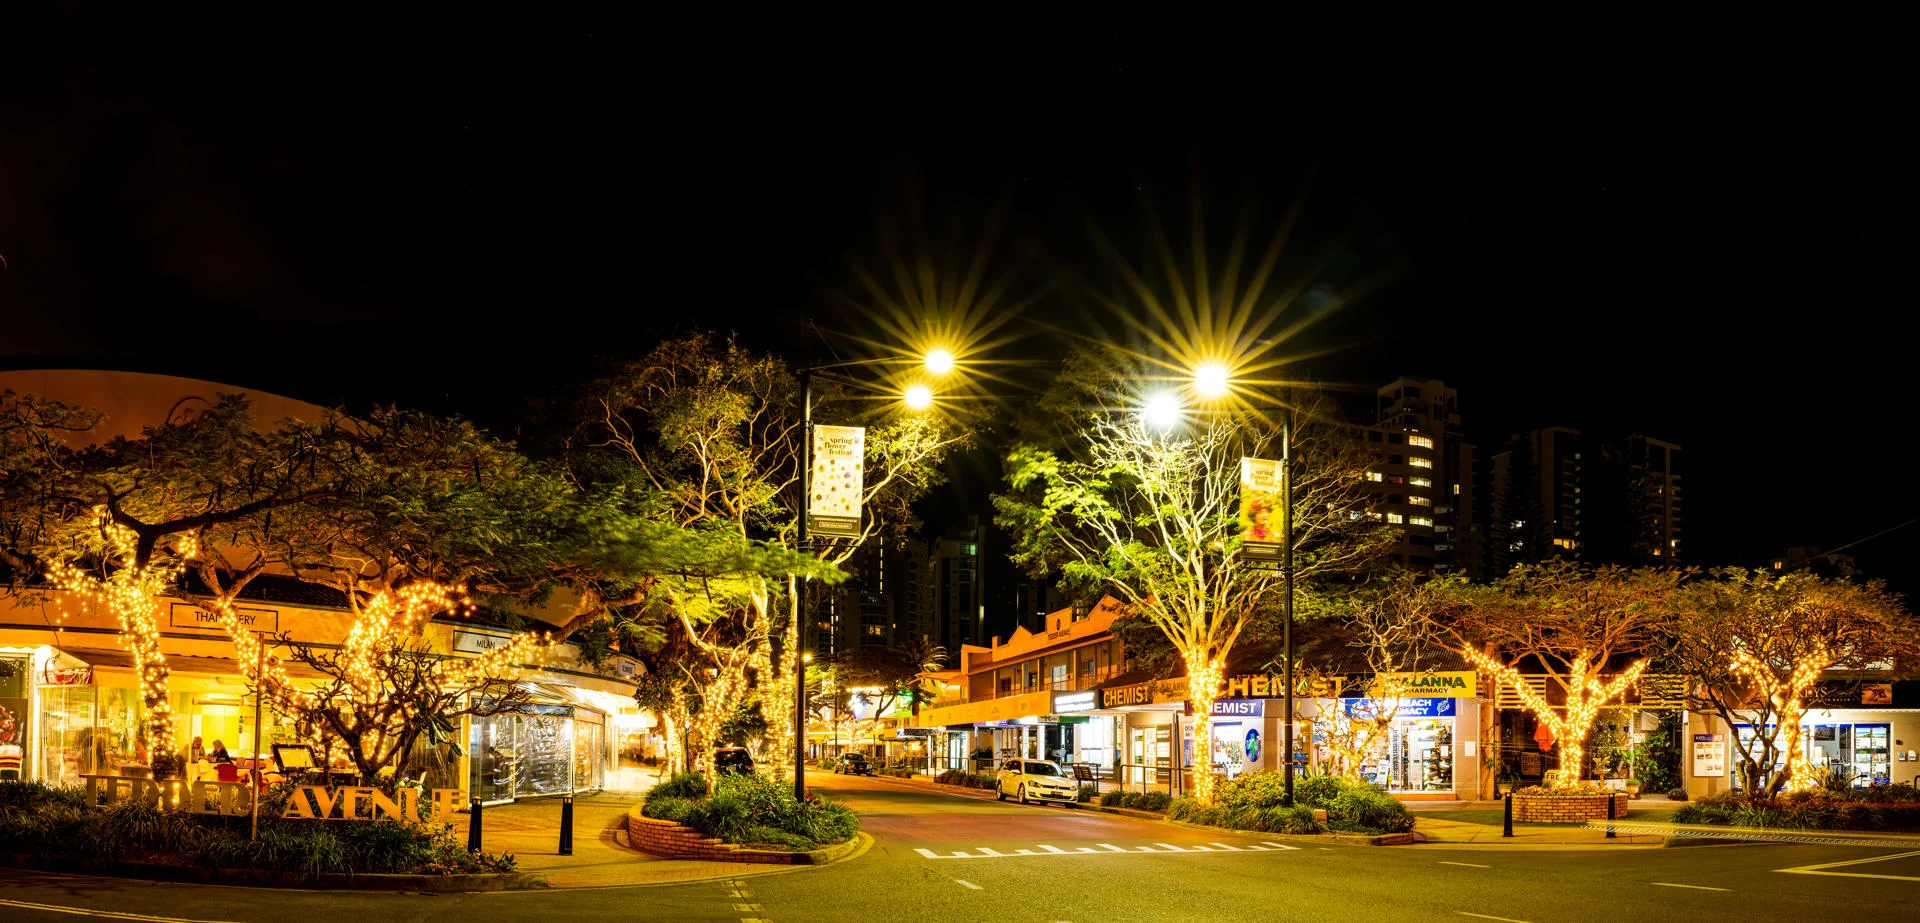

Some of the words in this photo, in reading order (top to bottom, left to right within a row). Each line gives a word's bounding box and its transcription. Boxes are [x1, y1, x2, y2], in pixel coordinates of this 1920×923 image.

[195, 611, 219, 623] THAI
[237, 614, 256, 625] ERY
[476, 639, 496, 649] MILAN
[1391, 676, 1466, 688] ALANNA
[1103, 685, 1149, 707] CHEMIST
[1208, 702, 1257, 714] EMIST
[281, 785, 468, 824] AVENUE
